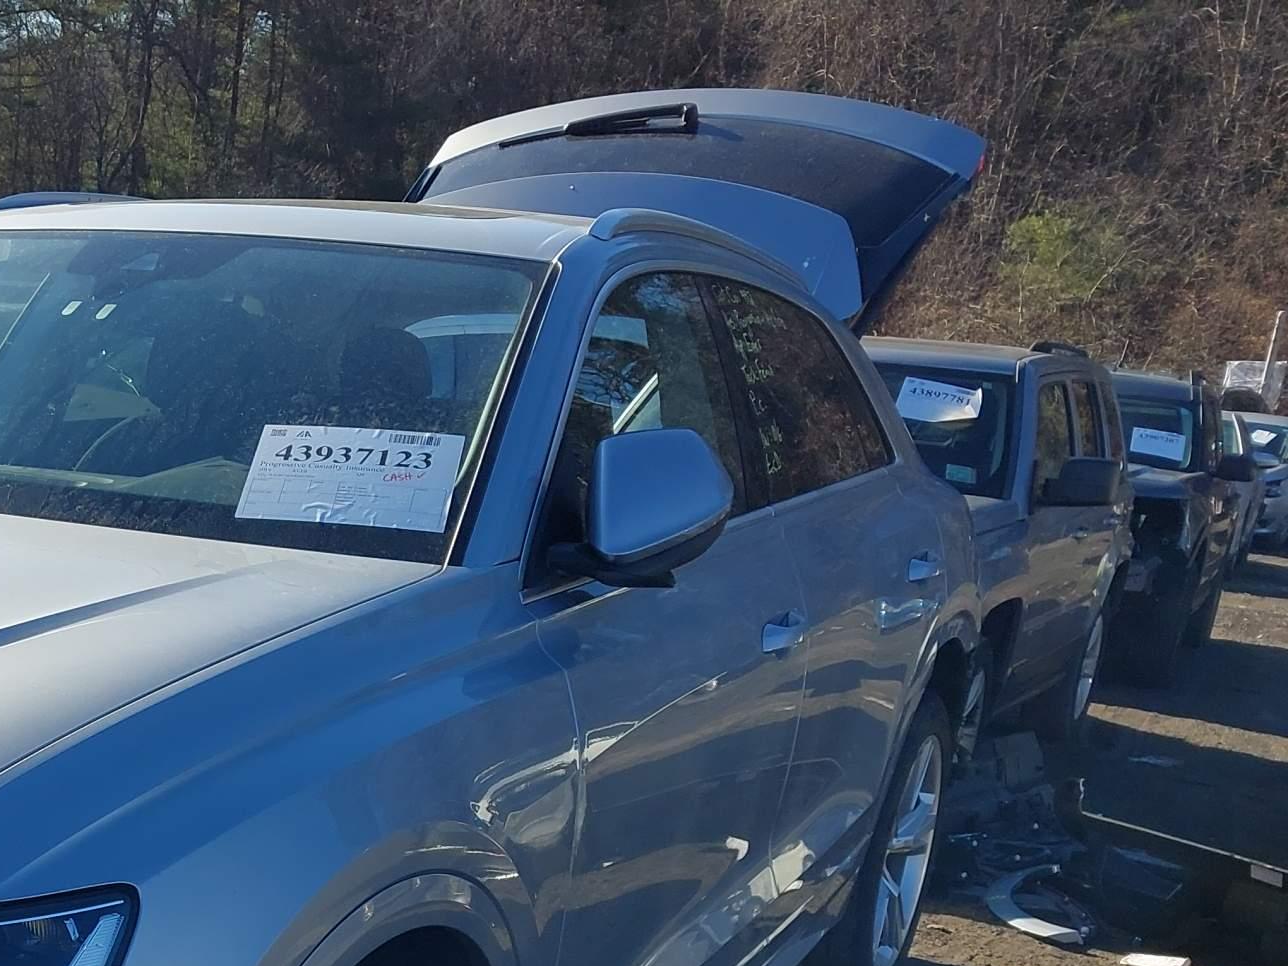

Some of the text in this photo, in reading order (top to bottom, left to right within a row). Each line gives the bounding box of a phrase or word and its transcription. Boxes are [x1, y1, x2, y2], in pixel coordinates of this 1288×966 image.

[910, 387, 972, 406] 43897781
[275, 444, 433, 470] 43937123
[383, 472, 413, 482] CASH
